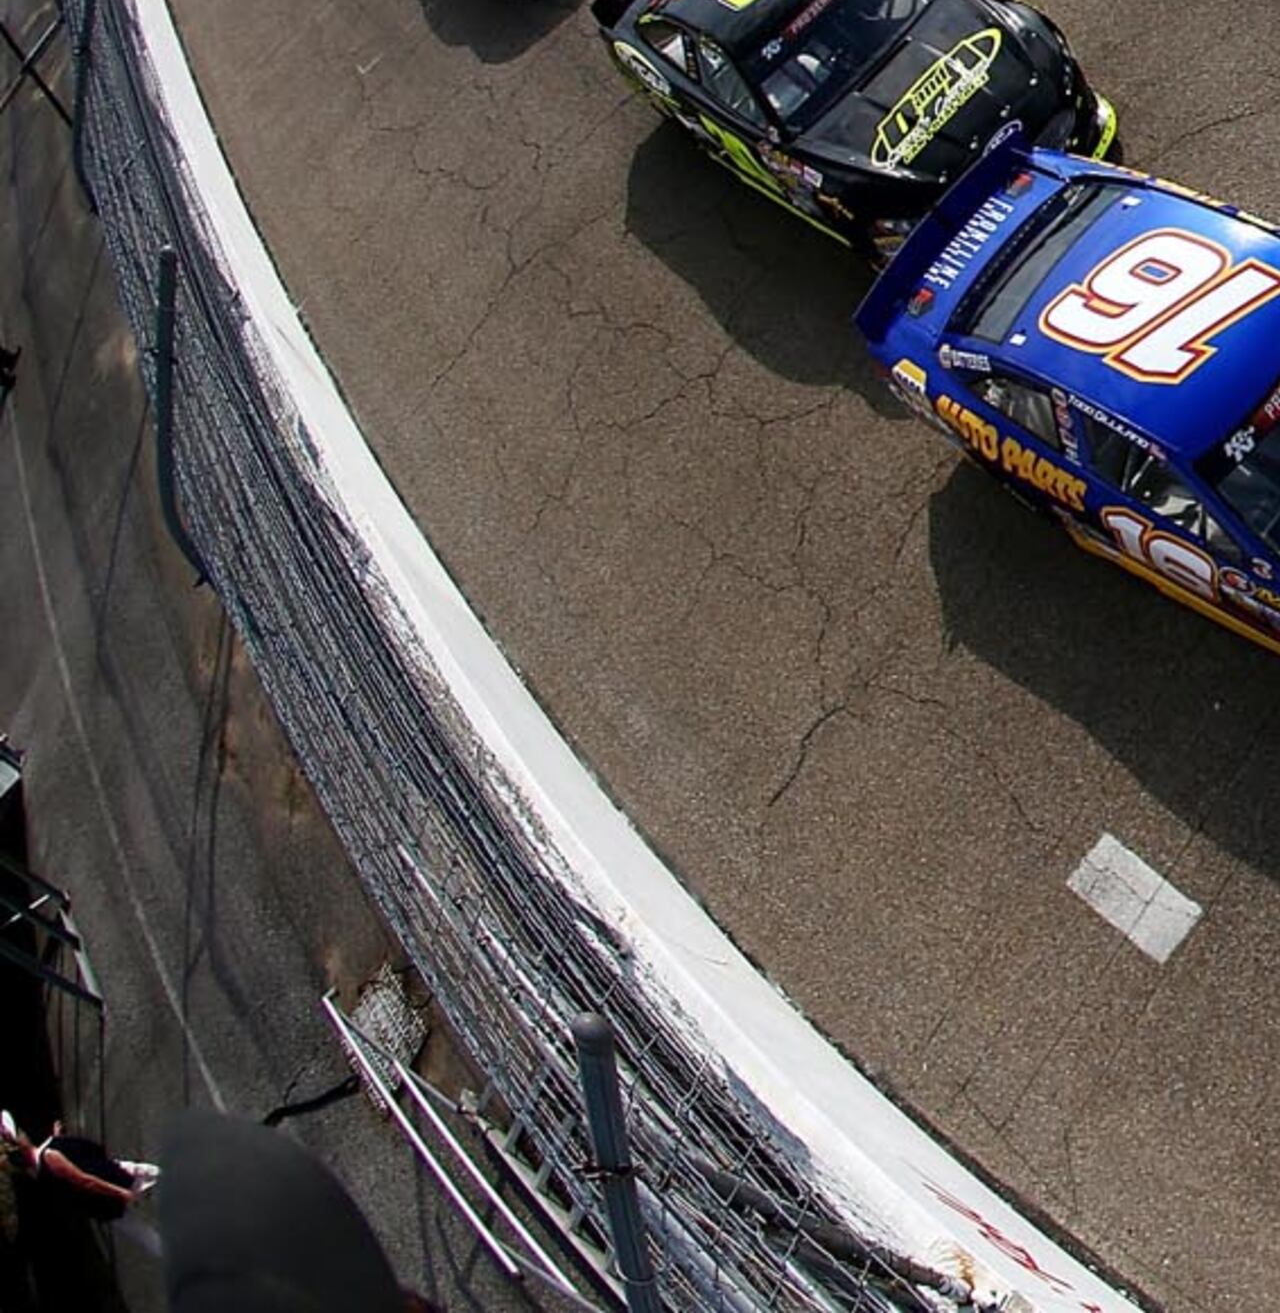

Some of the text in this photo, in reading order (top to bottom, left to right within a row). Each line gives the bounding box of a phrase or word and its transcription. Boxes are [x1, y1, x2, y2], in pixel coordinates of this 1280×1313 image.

[938, 200, 1014, 290] FRONTLINE
[936, 394, 998, 461] AUTO
[1002, 438, 1088, 511] PARTS
